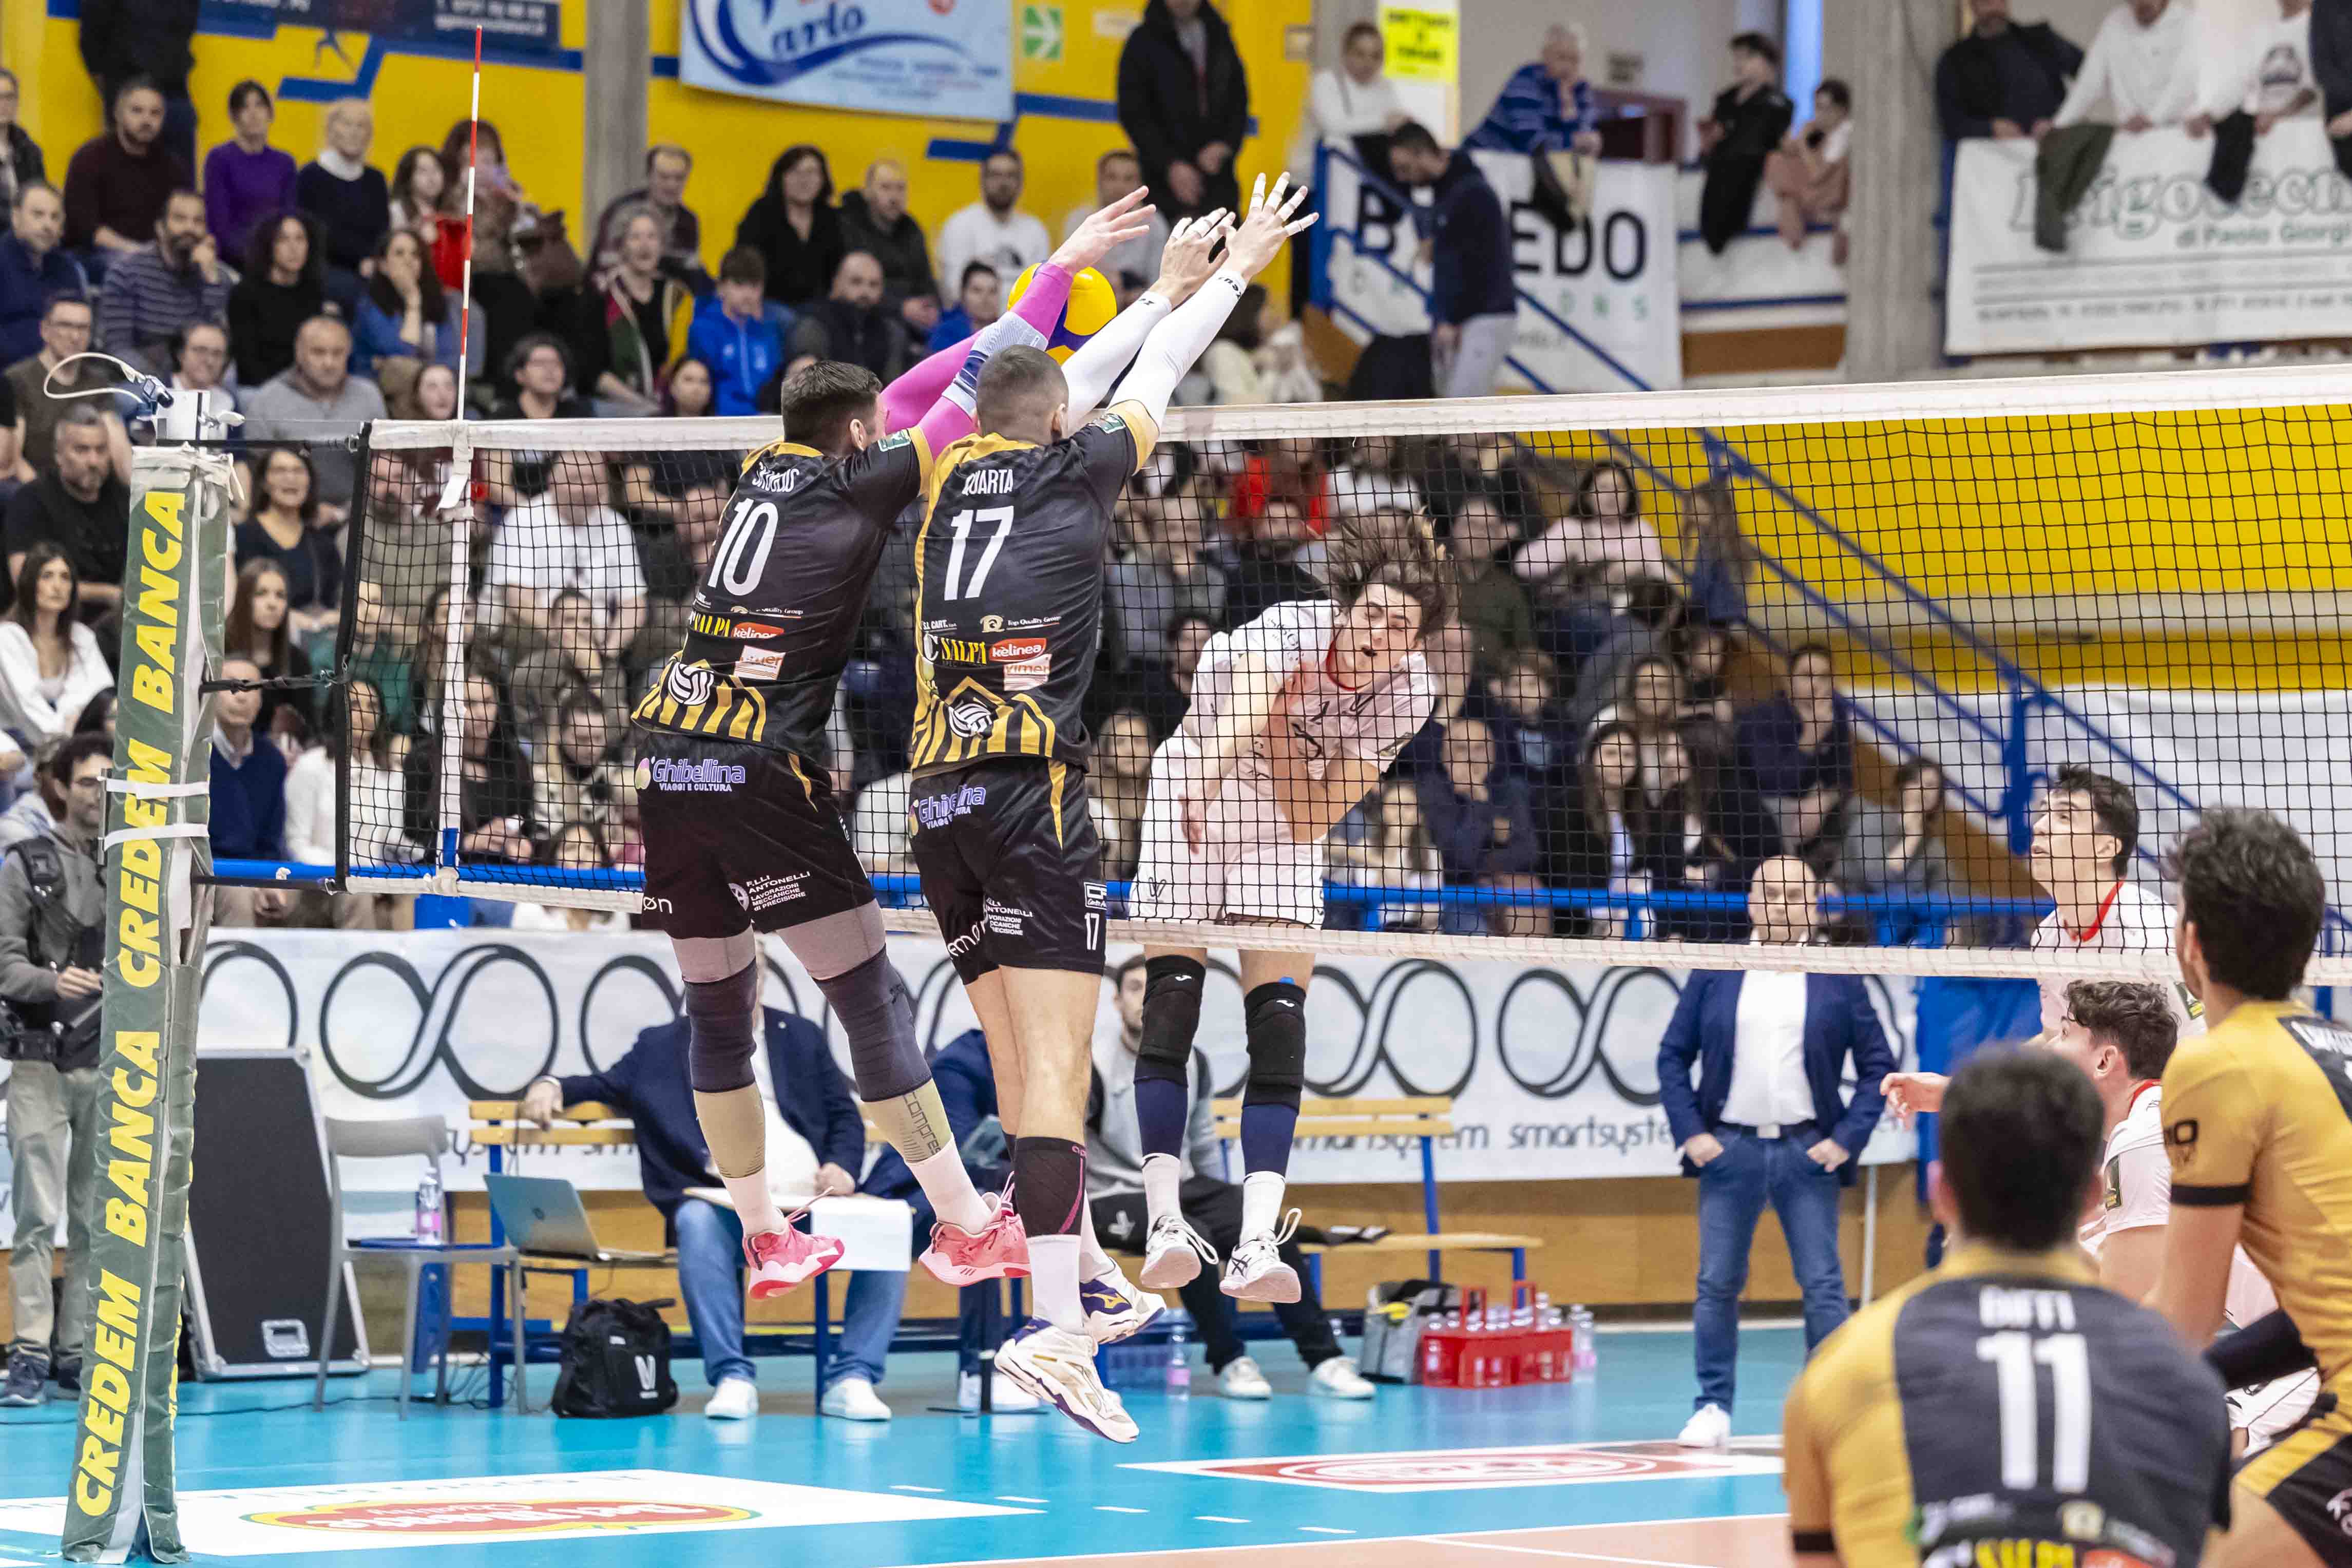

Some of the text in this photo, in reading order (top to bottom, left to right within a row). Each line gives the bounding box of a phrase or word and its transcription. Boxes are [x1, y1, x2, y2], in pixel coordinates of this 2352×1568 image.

[962, 469, 1014, 495] QUARTA
[708, 498, 778, 596] 10
[944, 506, 1014, 601] 17
[132, 491, 186, 715] BANCA
[1020, 616, 1042, 625] Quality
[991, 643, 1043, 658] kèlinea
[653, 758, 745, 783] Ghibellina
[659, 783, 685, 791] VIAGGI
[694, 783, 733, 792] CULTURA
[118, 738, 173, 989] CREDEM
[746, 875, 770, 887] F.LLI
[749, 871, 811, 894] ANTONELLI
[751, 882, 799, 901] LAVORAZIONI
[752, 887, 801, 907] MECCANICHE
[762, 891, 806, 909] PRECISIONE
[1084, 912, 1100, 951] 17
[105, 1030, 160, 1248] BANCA
[75, 1268, 141, 1517] CREDEM
[1976, 1331, 2092, 1494] 11
